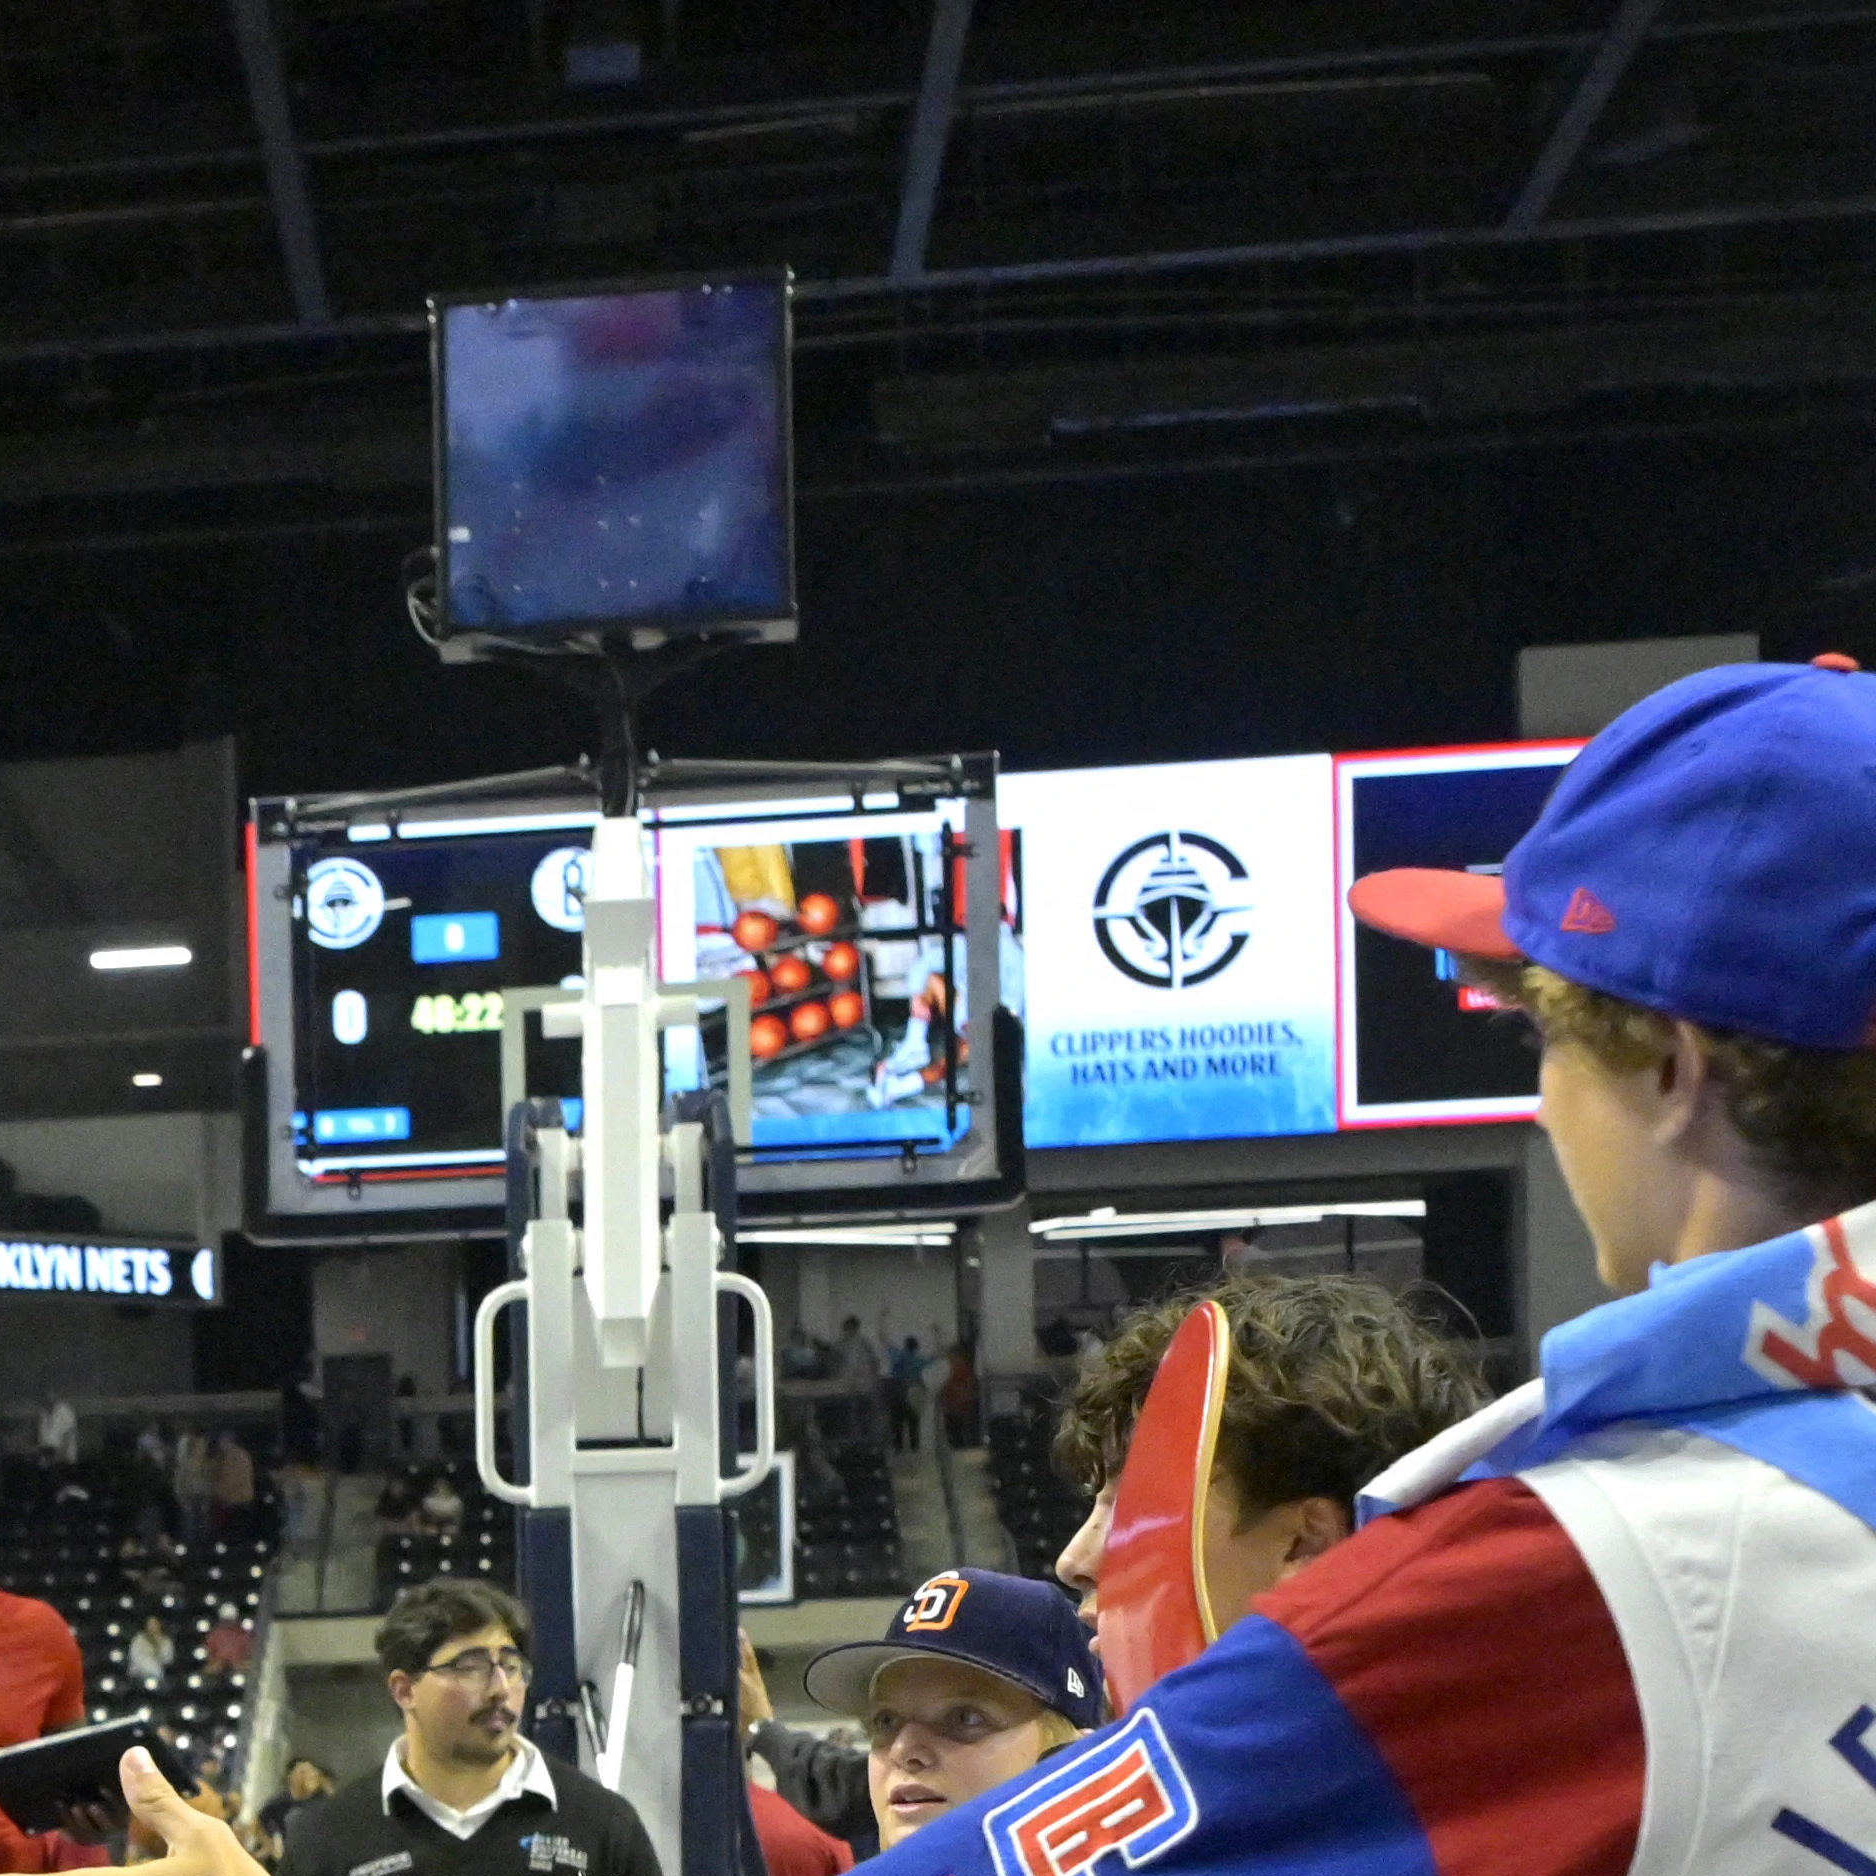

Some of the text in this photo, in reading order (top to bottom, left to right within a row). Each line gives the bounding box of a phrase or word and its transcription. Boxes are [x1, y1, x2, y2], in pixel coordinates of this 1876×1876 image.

[1050, 1020, 1303, 1059] CLIPPERS HOODIES,
[1070, 1051, 1281, 1086] HATS AND MORE
[84, 1246, 173, 1296] NETS
